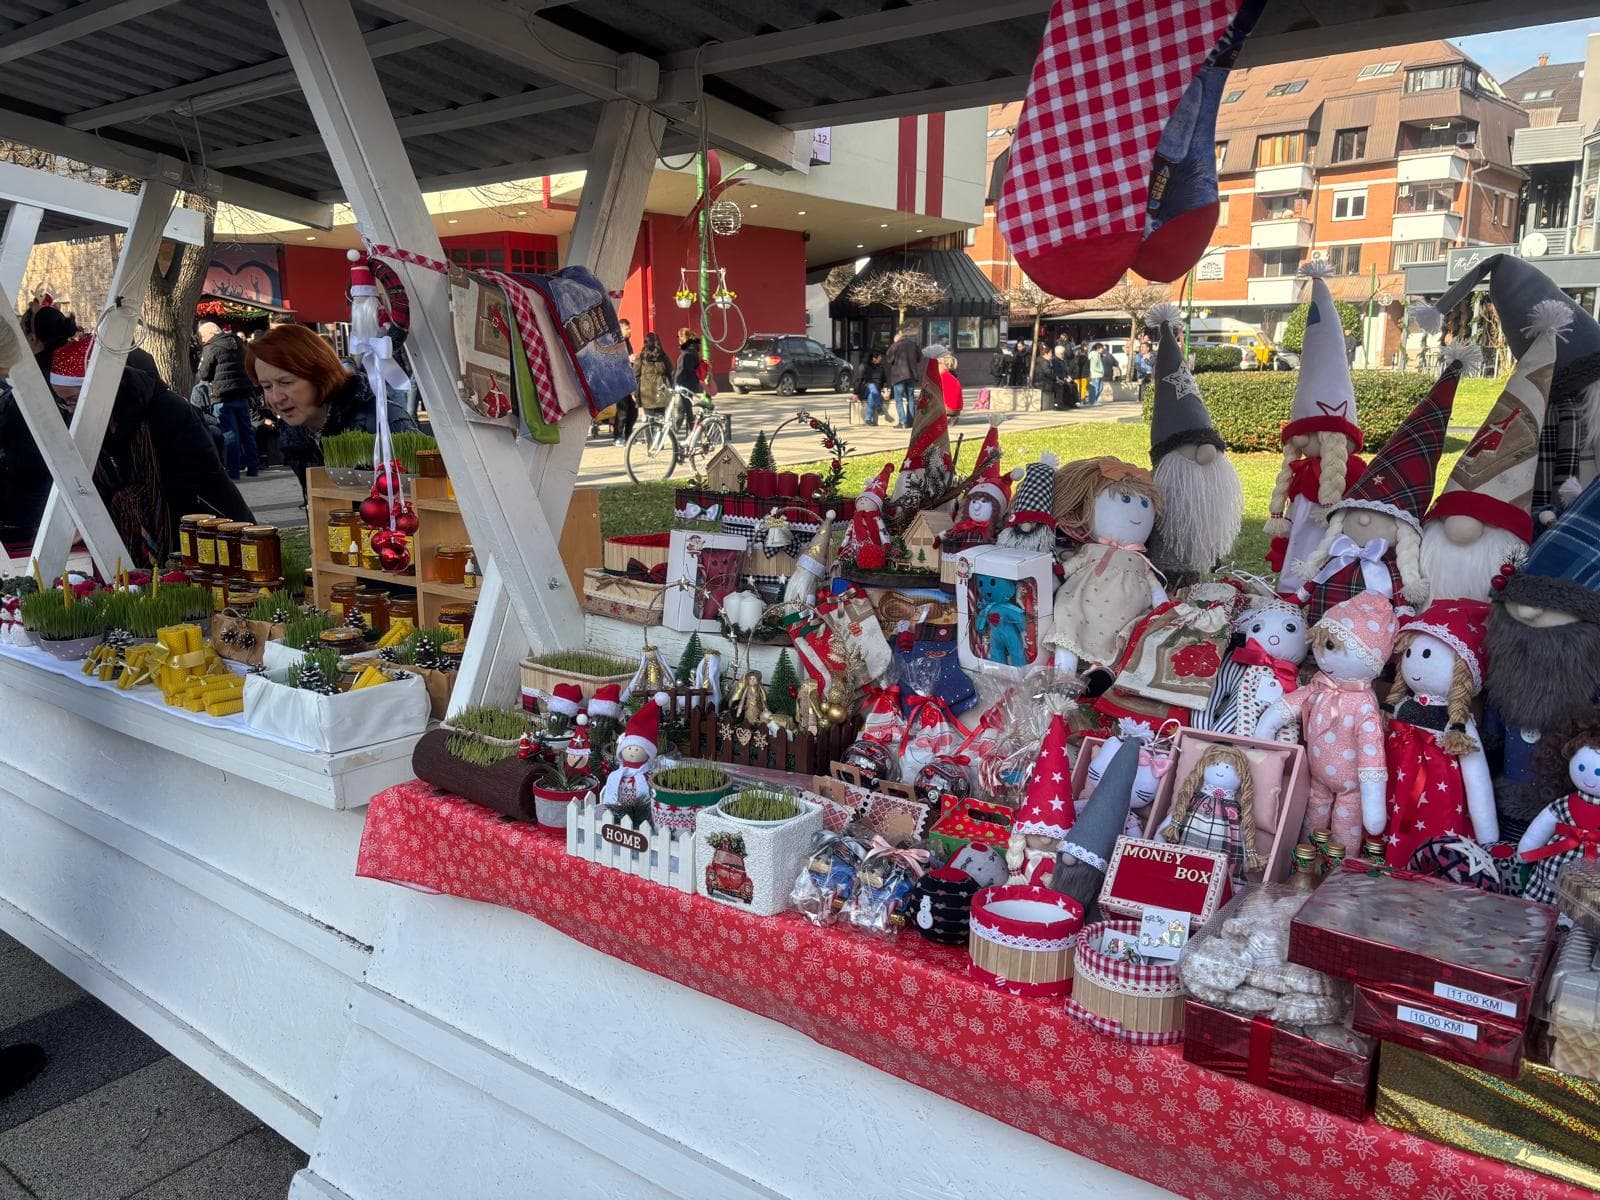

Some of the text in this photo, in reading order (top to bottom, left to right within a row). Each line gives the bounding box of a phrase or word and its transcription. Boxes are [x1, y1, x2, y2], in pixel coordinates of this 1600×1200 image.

[813, 134, 830, 145] .12.
[606, 827, 641, 850] HOME
[1123, 844, 1187, 866] MONEY
[1174, 866, 1212, 885] BOX
[1482, 998, 1500, 1011] KM
[1443, 1020, 1461, 1032] KM
